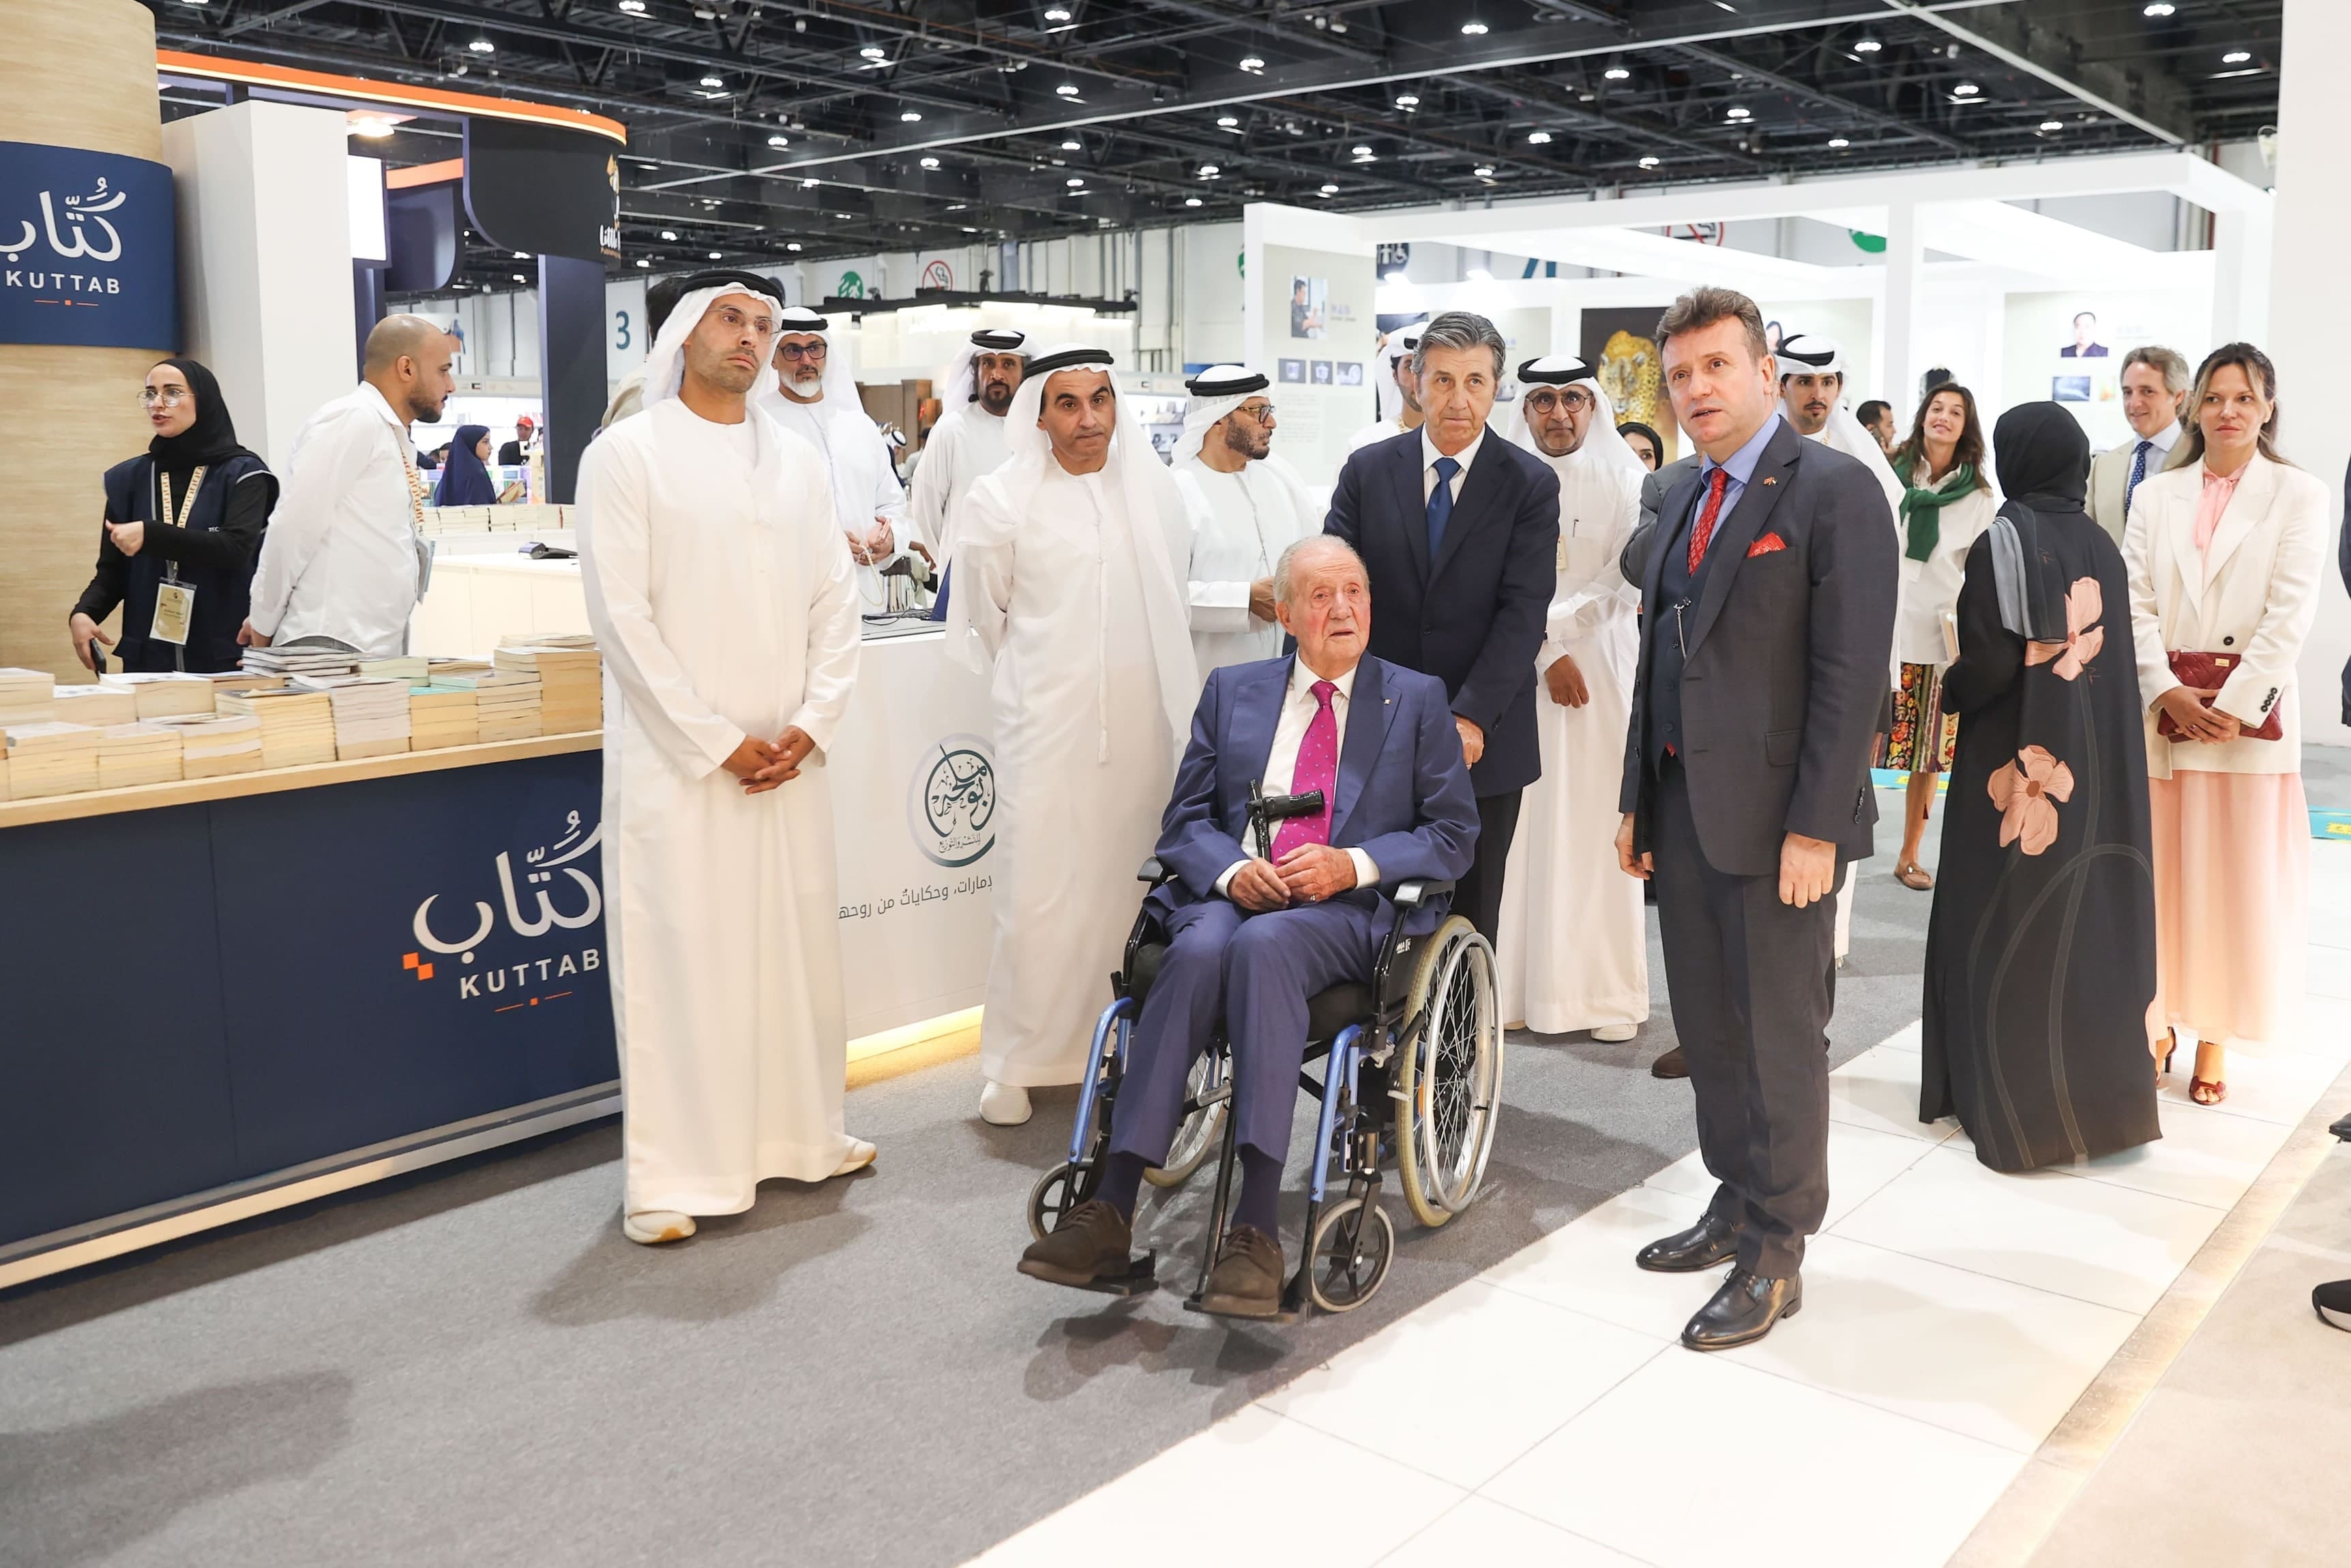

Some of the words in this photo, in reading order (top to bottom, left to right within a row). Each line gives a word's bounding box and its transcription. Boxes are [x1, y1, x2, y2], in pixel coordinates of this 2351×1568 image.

[5, 270, 120, 294] KUTTAB
[616, 310, 631, 349] 3
[877, 898, 895, 915] من
[460, 949, 600, 999] KUTTAB
